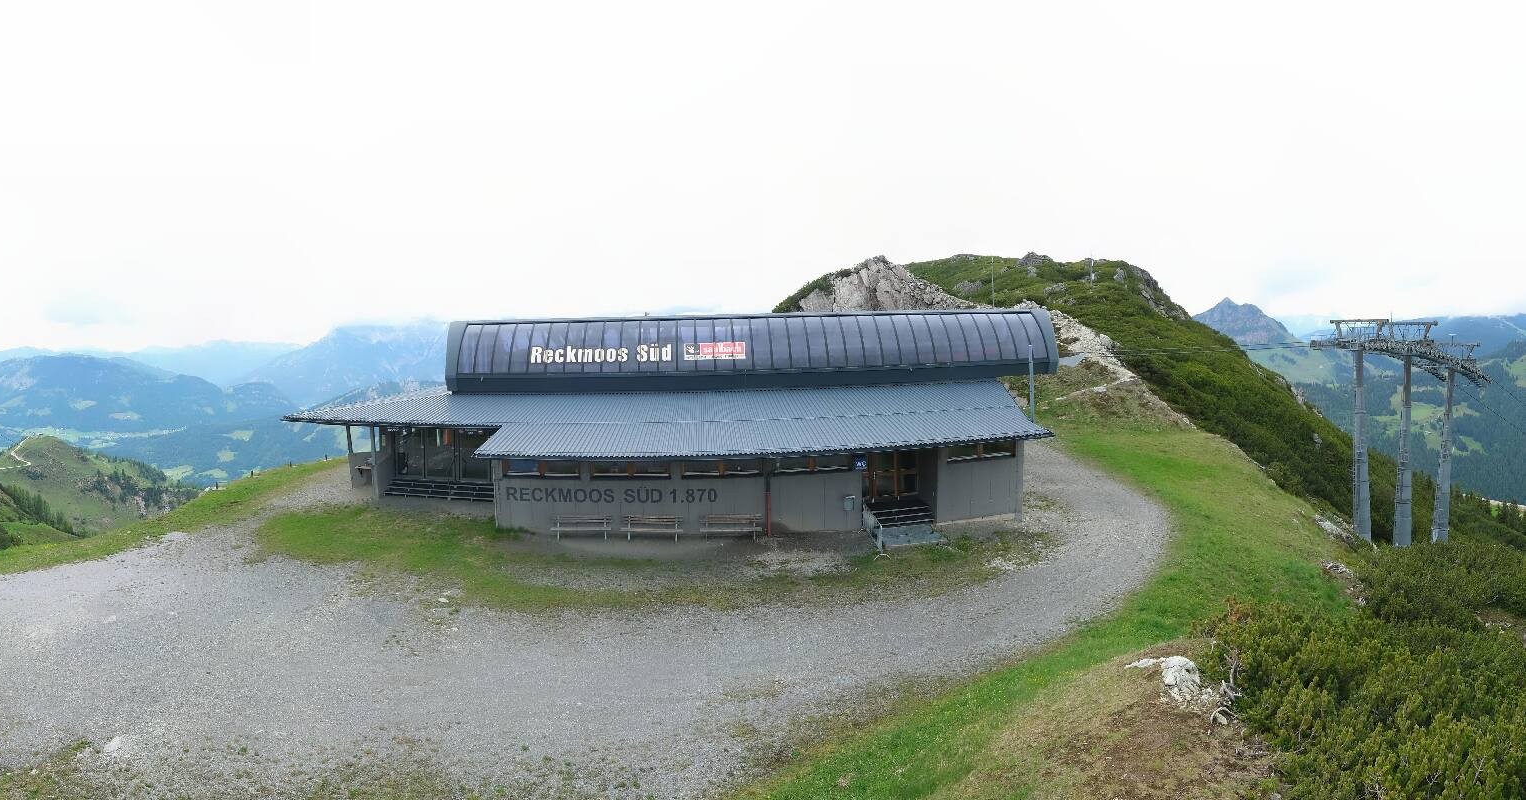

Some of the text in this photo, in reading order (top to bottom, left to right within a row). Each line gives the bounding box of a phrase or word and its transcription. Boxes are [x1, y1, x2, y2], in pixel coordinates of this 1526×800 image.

[530, 343, 672, 363] Reckmoos Süd
[505, 486, 718, 504] RECKMOOS SÜD 1.870
